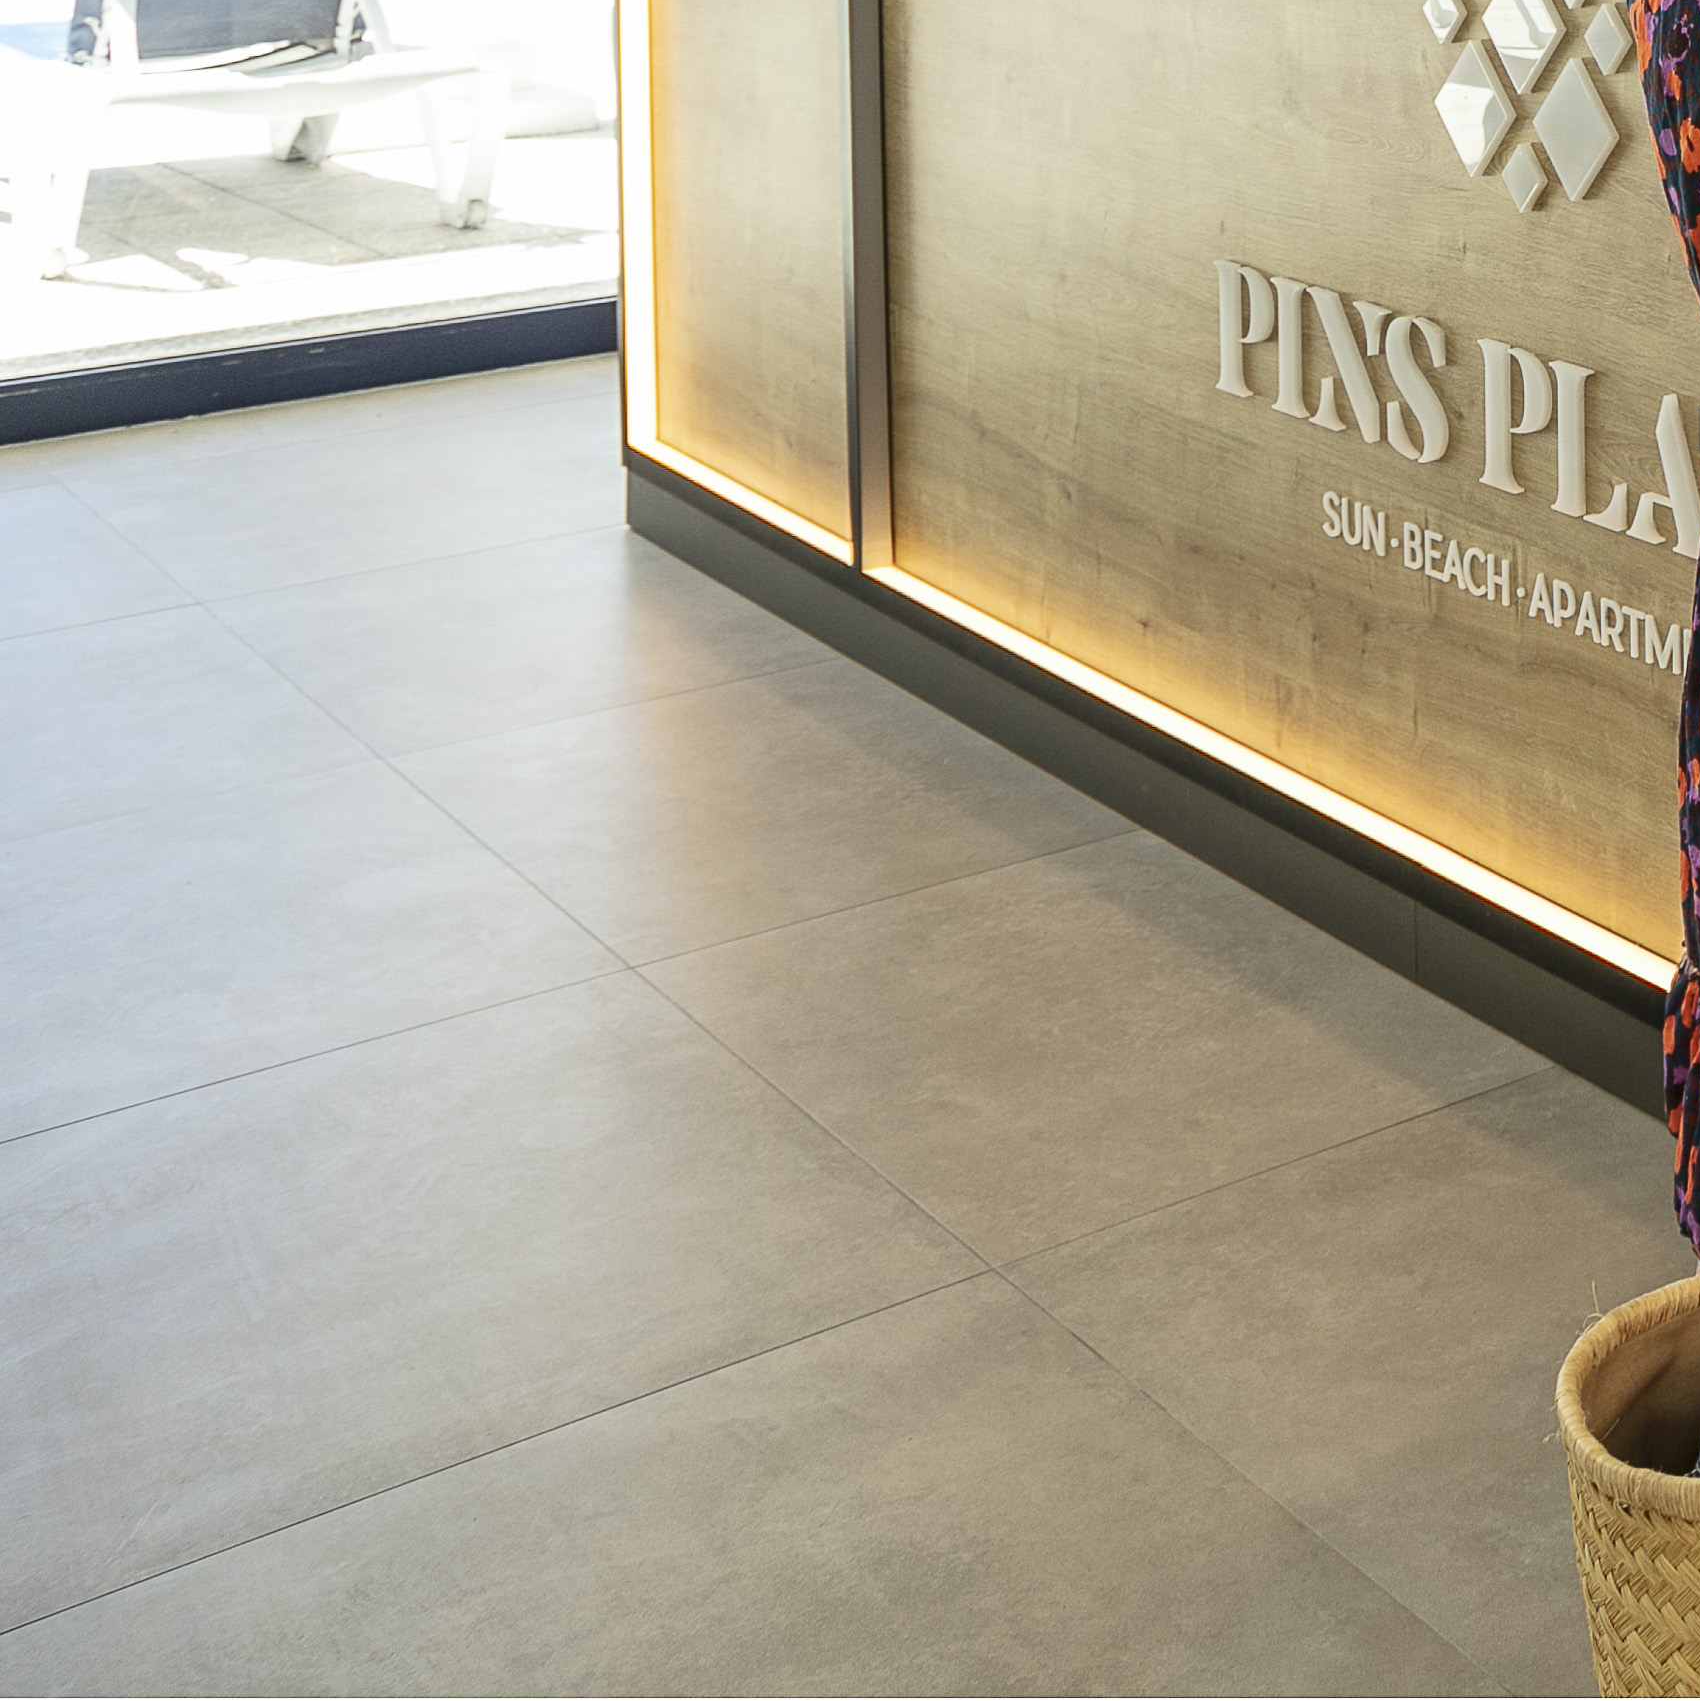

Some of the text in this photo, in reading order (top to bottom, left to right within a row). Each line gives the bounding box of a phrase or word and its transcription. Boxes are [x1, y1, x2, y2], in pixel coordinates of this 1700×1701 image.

[1213, 260, 1449, 463] PINS
[1322, 490, 1692, 678] SUN BEACH APARTM
